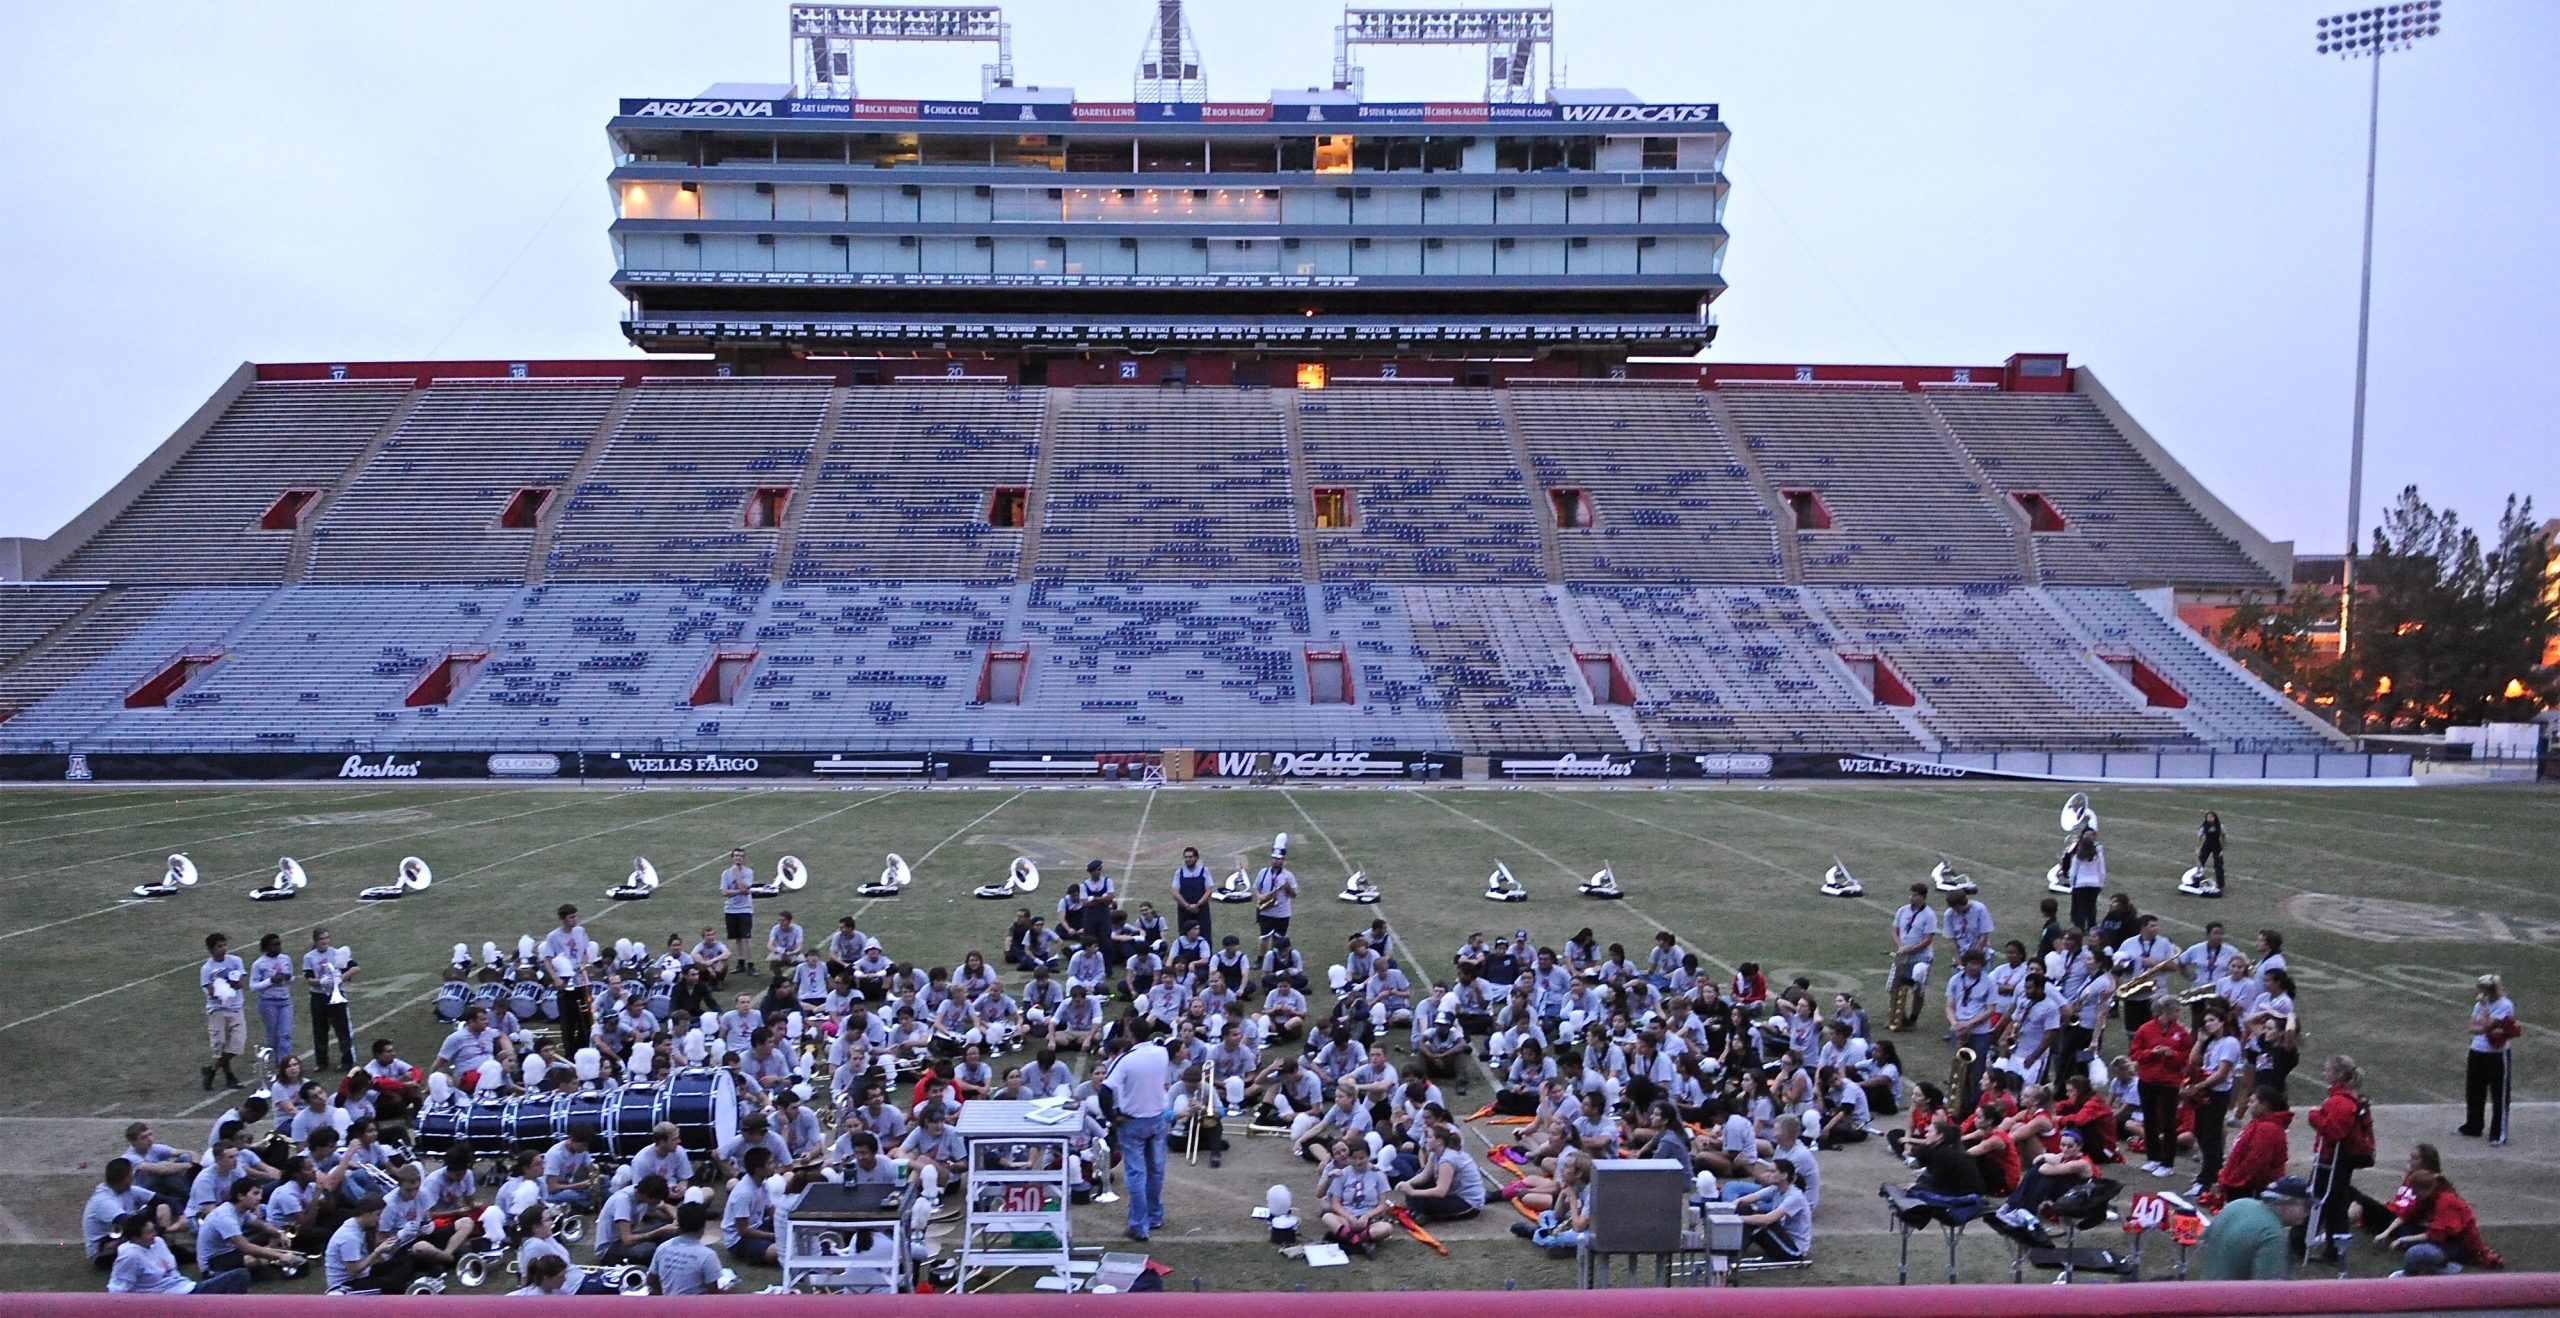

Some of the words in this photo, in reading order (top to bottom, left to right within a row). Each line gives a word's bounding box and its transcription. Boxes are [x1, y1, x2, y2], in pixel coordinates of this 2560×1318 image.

[634, 102, 773, 118] ARIZONA
[791, 103, 801, 112] 22
[801, 104, 816, 112] ART
[817, 104, 850, 113] LUPPINO
[864, 105, 887, 113] RICKY
[888, 105, 918, 114] HUNLEY
[930, 106, 957, 115] CHUCK
[958, 106, 979, 115] CECIL
[1211, 108, 1228, 117] ROB
[1229, 108, 1265, 117] WALDROP
[1527, 108, 1552, 118] CASON
[1562, 106, 1711, 121] WILDCATS
[332, 370, 345, 379] 17
[512, 368, 526, 379] 18
[717, 367, 730, 377] 19
[947, 367, 963, 377] 20
[1122, 366, 1135, 377] 21
[1382, 368, 1396, 378] 22
[1611, 369, 1625, 380] 23
[1797, 371, 1811, 381] 24
[338, 754, 421, 777] Bashas'
[627, 758, 692, 772] WELLS
[696, 758, 759, 772] FARGO
[1218, 752, 1370, 776] WIDCATS
[1838, 758, 1902, 773] WELLS
[1008, 1187, 1040, 1212] 50
[2129, 1196, 2165, 1228] 40
